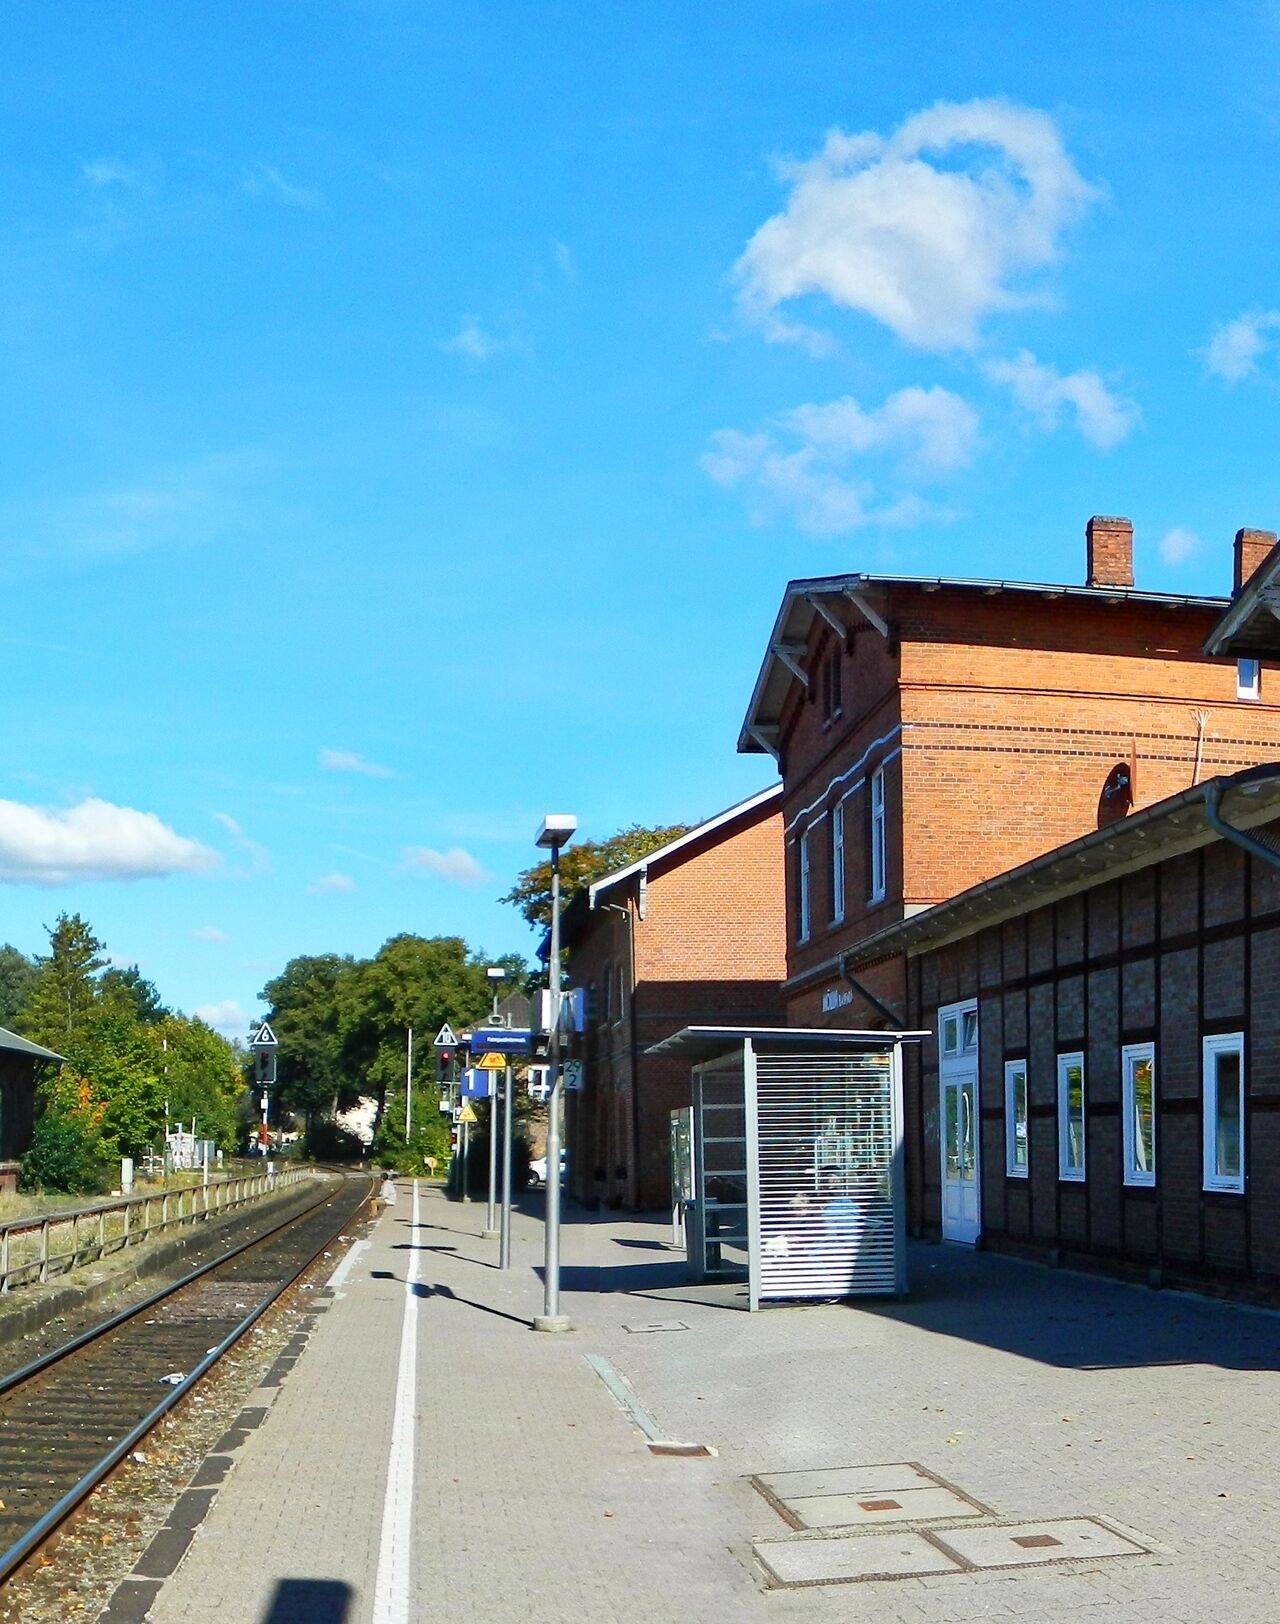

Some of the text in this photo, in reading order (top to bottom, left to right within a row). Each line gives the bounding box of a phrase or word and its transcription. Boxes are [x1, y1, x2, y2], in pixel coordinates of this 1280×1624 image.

[261, 1029, 269, 1041] 6
[442, 1032, 451, 1043] 10
[565, 1060, 581, 1072] 29
[464, 1068, 474, 1090] 1
[569, 1074, 577, 1087] 2
